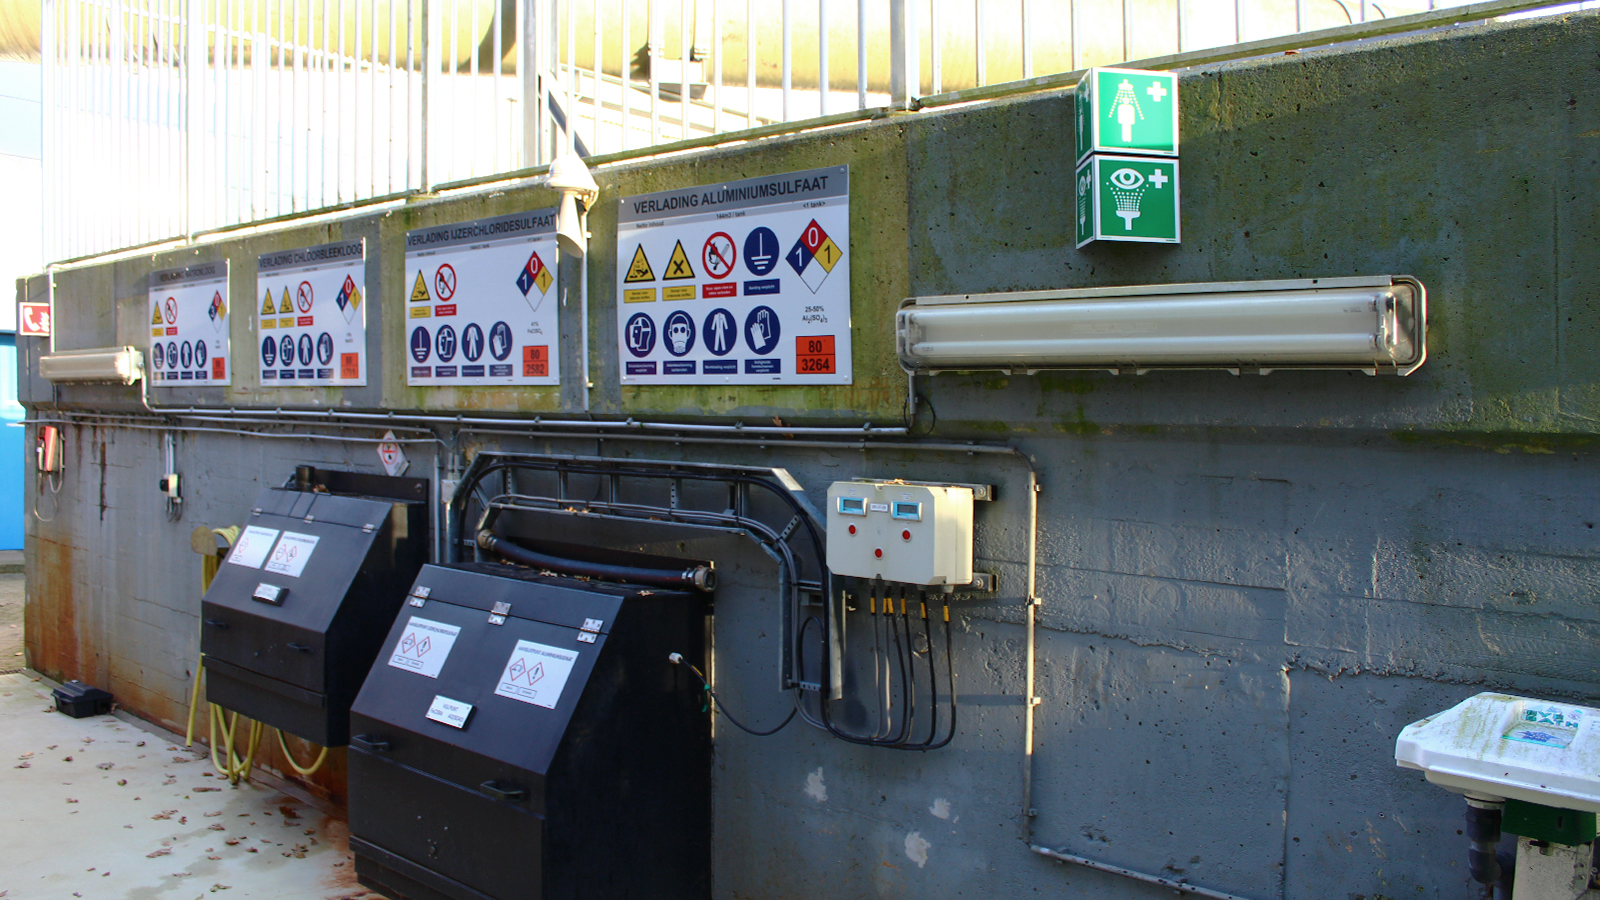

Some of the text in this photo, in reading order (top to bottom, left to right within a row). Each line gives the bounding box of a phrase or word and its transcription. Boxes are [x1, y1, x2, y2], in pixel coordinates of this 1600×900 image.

[634, 176, 829, 214] VERLADING ALUMINIUMSULFAAT
[408, 215, 555, 246] VERLADING IJZERCHLORIDESULFAAT
[808, 227, 818, 247] 0
[259, 244, 362, 268] VERLADING CHLOORBLEEKLOOG
[796, 247, 802, 266] 1
[824, 245, 830, 264] 1
[530, 257, 538, 274] 0
[346, 279, 352, 293] 0
[522, 273, 527, 290] 1
[541, 272, 546, 288] 1
[340, 293, 344, 306] 1
[530, 350, 540, 359] 80
[808, 340, 822, 353] 80
[526, 364, 544, 374] 2582
[802, 358, 830, 371] 3264
[1526, 710, 1564, 720] EYE
